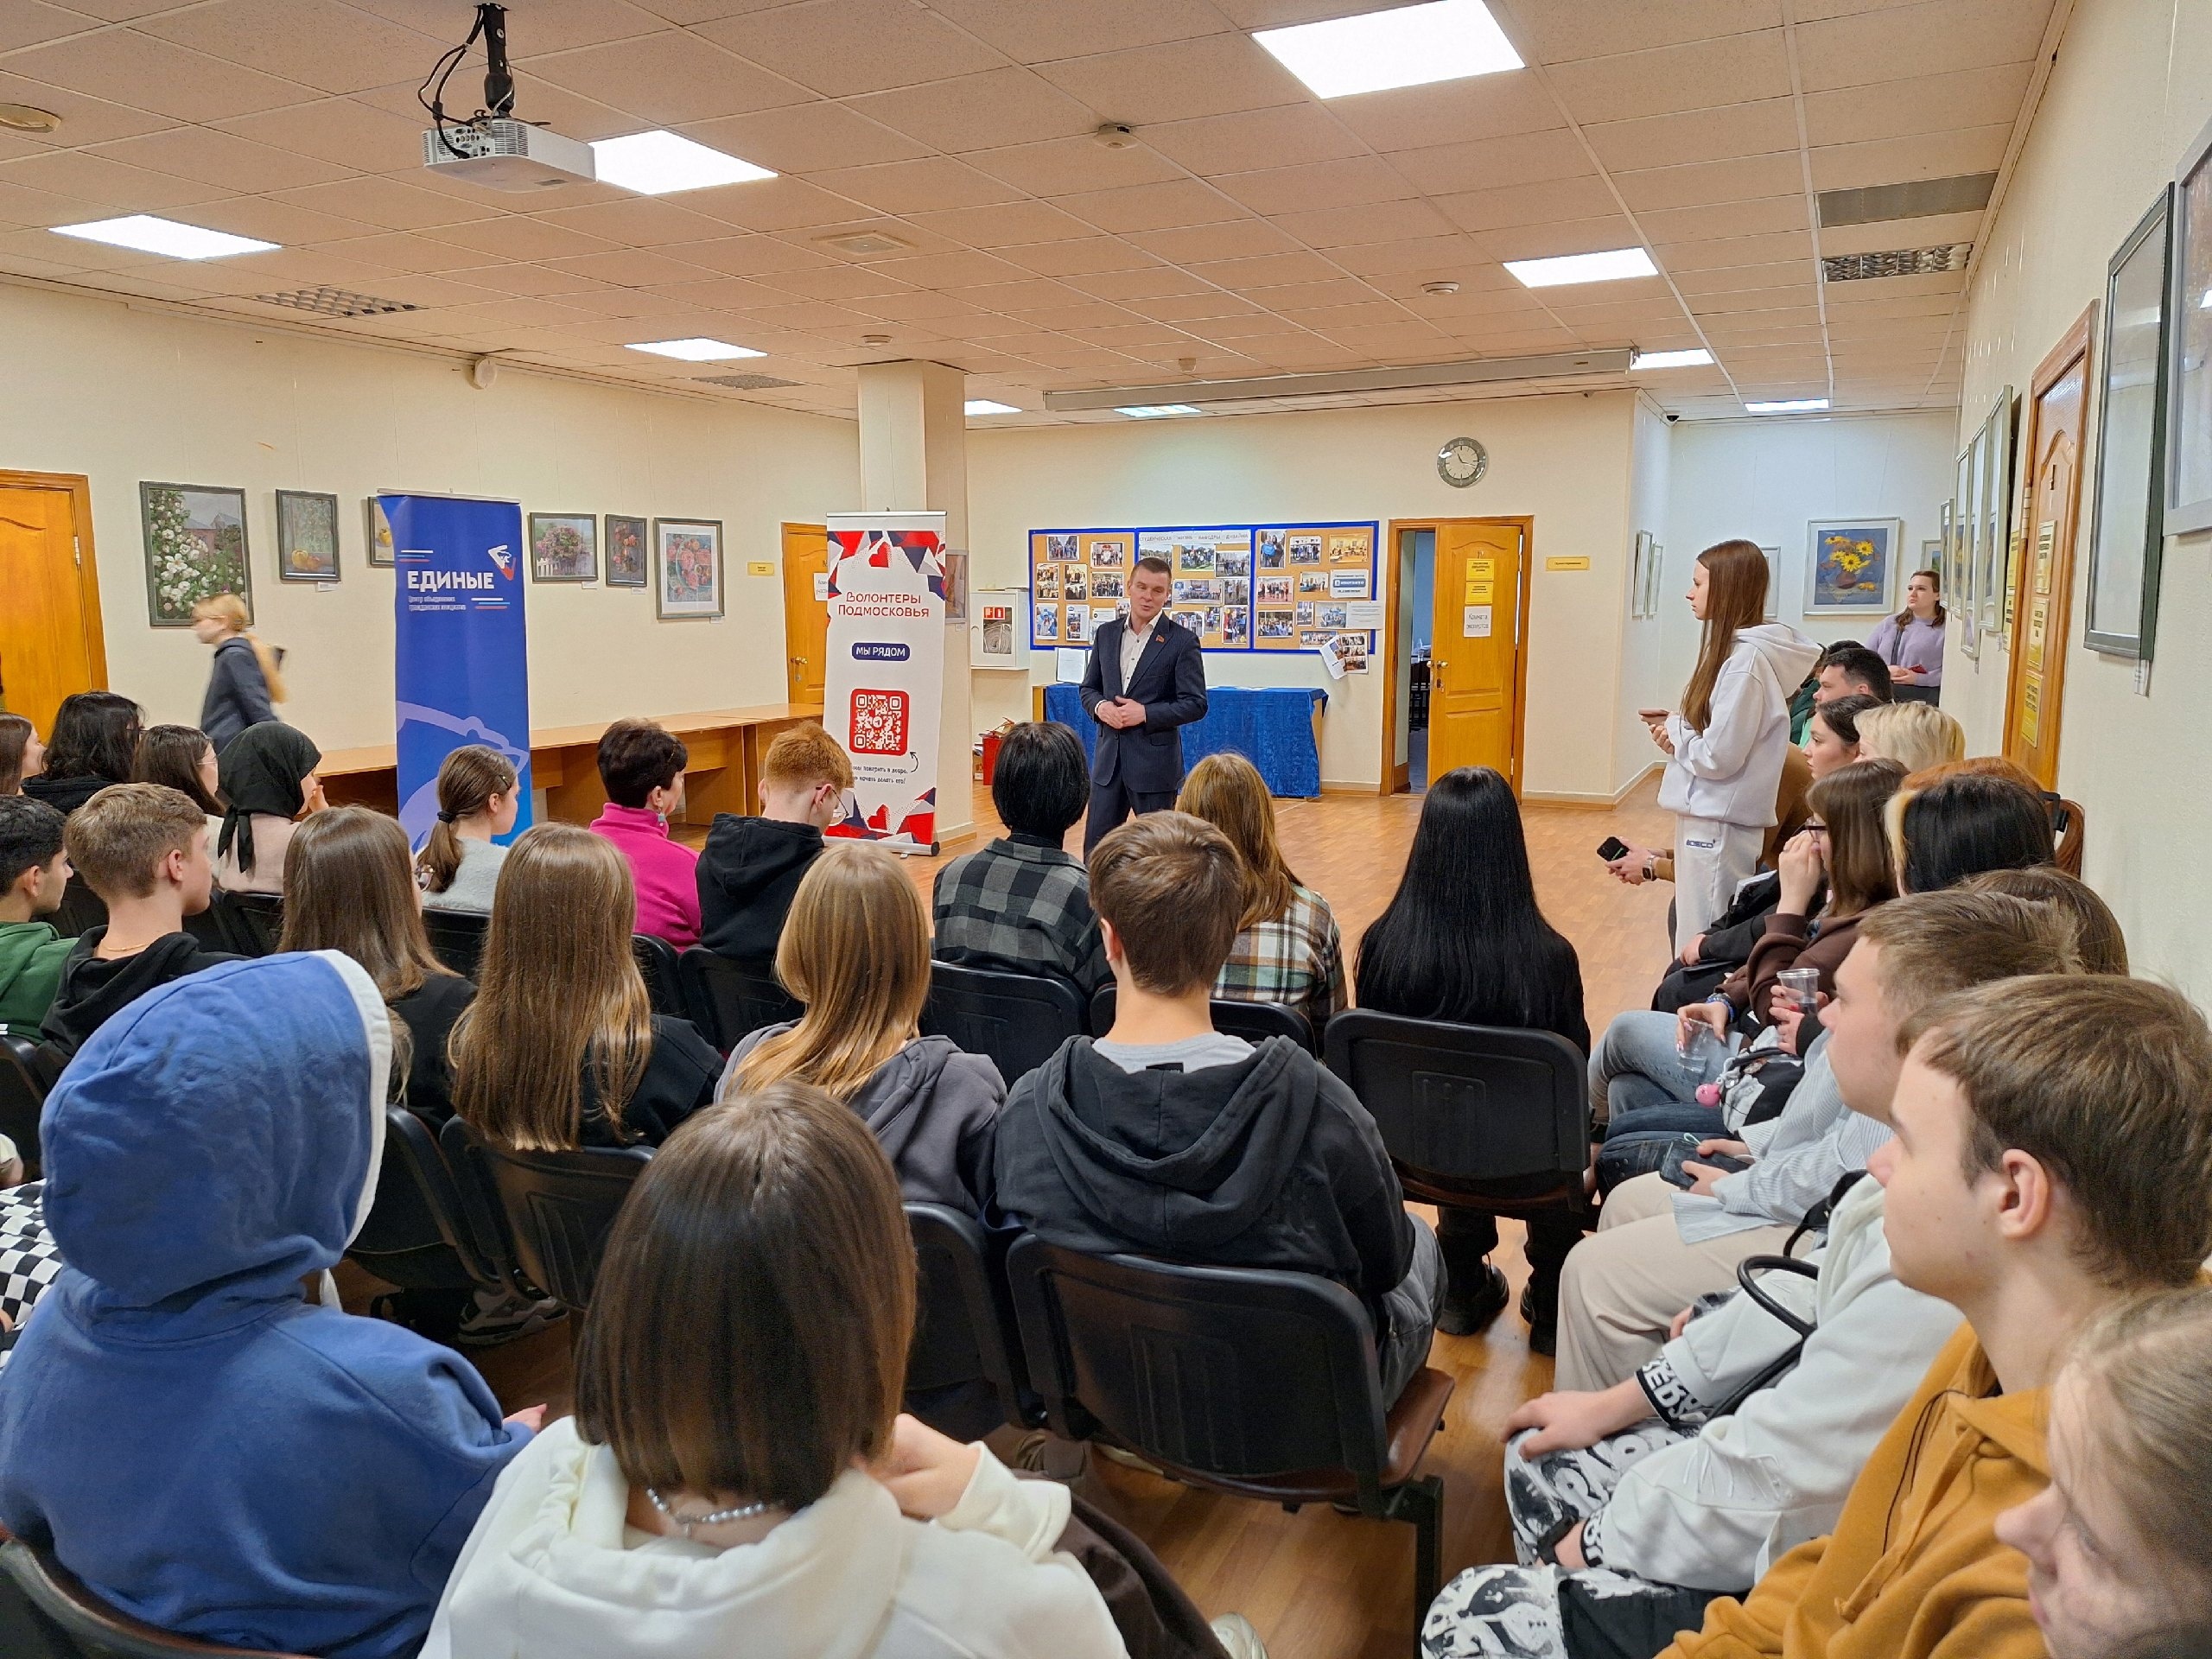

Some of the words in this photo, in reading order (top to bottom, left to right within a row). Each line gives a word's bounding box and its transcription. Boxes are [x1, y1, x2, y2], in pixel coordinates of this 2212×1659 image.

[407, 570, 495, 593] ЕДИНЫЕ
[855, 646, 871, 656] МЫ
[872, 646, 906, 658] РЯДОМ
